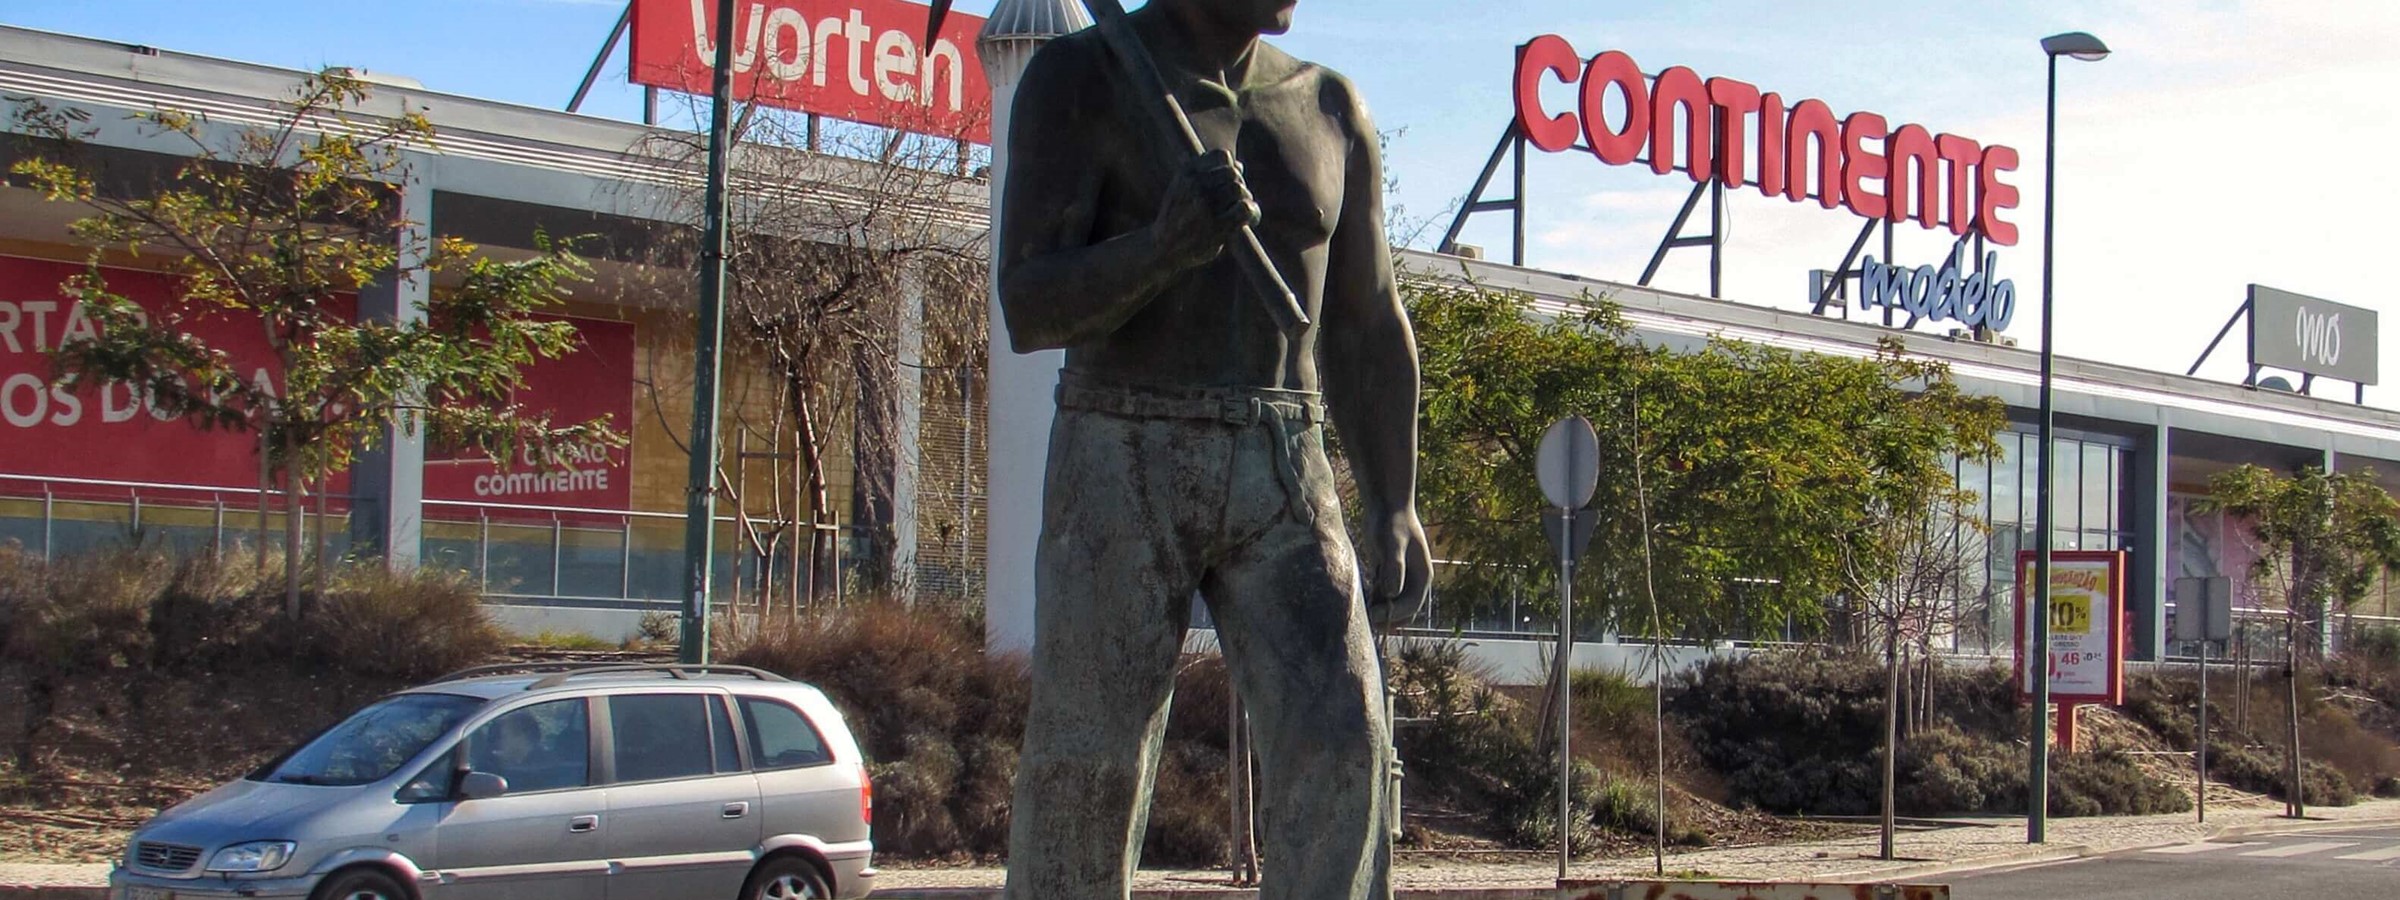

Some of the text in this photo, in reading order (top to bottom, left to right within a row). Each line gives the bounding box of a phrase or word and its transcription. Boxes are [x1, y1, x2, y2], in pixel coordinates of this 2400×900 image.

[1513, 34, 2019, 246] CONTINENTE
[1861, 240, 2015, 332] modelo
[474, 469, 608, 496] CONTINENTE
